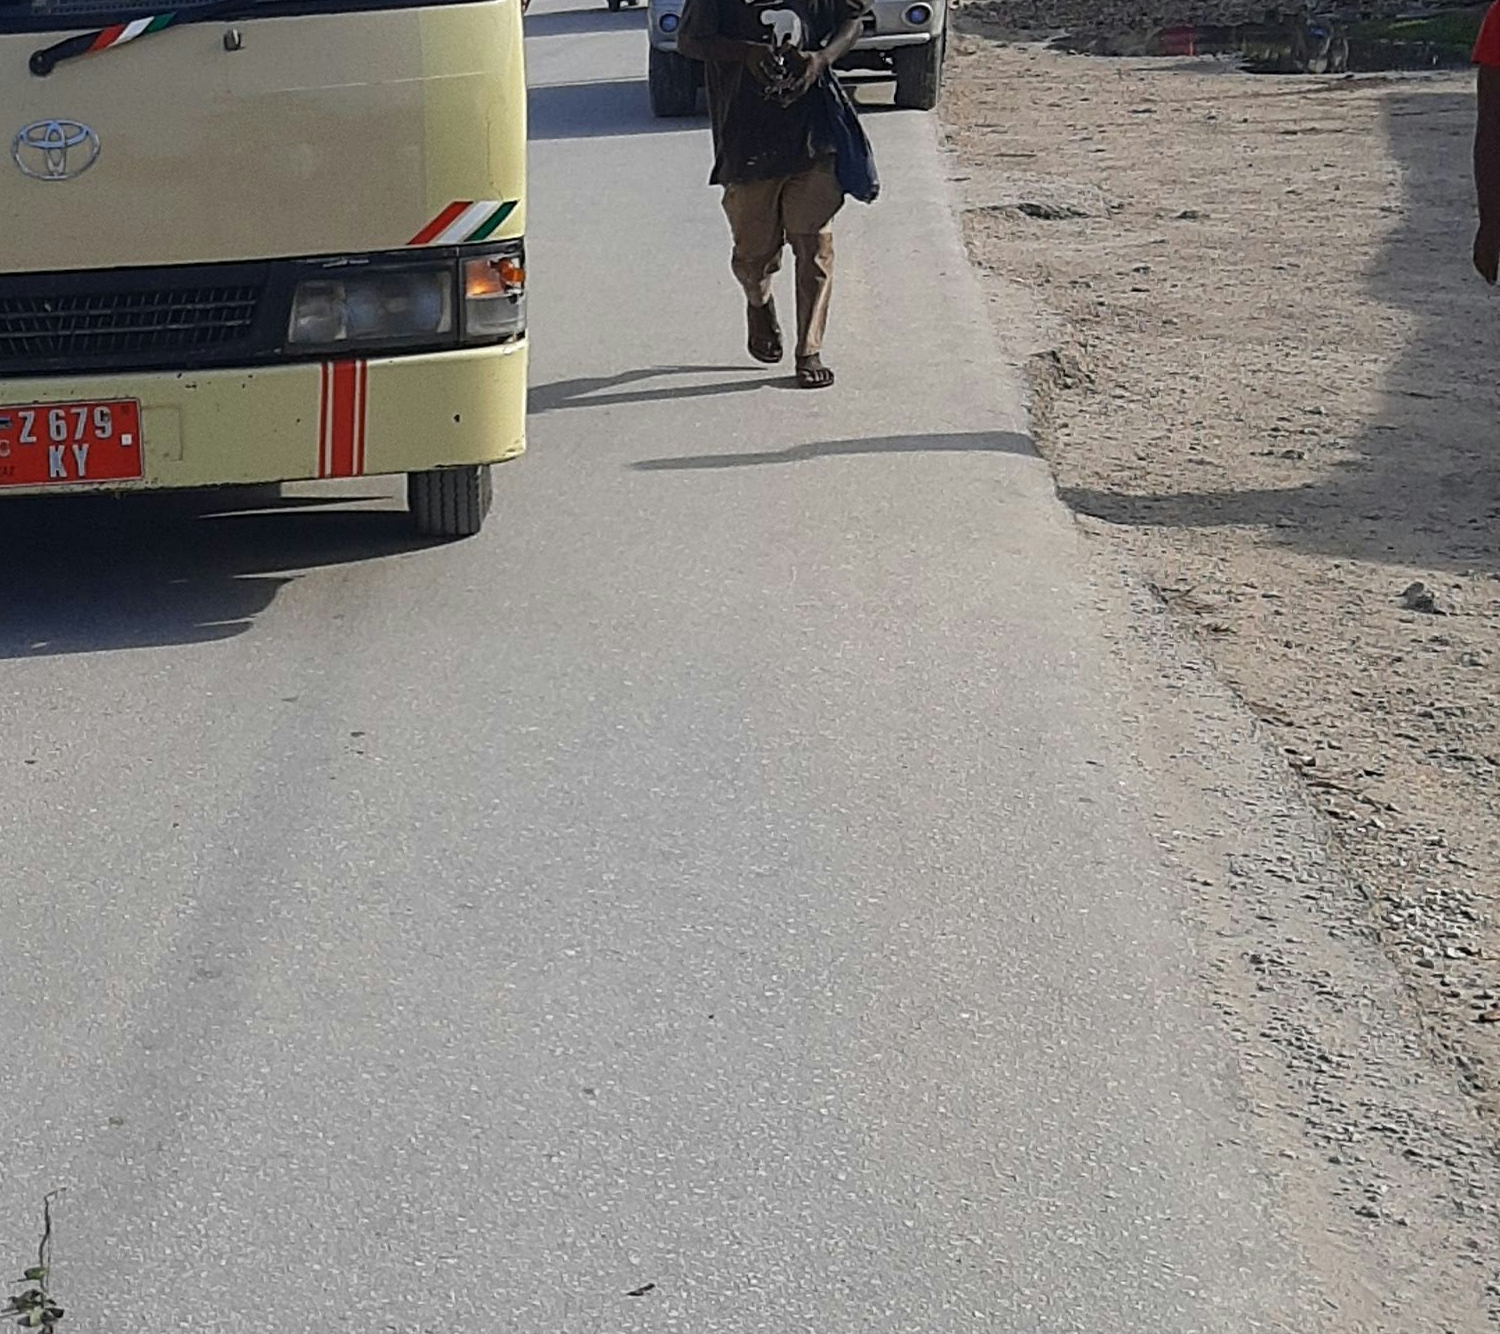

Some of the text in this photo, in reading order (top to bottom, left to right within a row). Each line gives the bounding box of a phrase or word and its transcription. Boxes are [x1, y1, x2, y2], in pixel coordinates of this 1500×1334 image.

[18, 406, 113, 444] Z 679
[48, 443, 89, 479] KY
